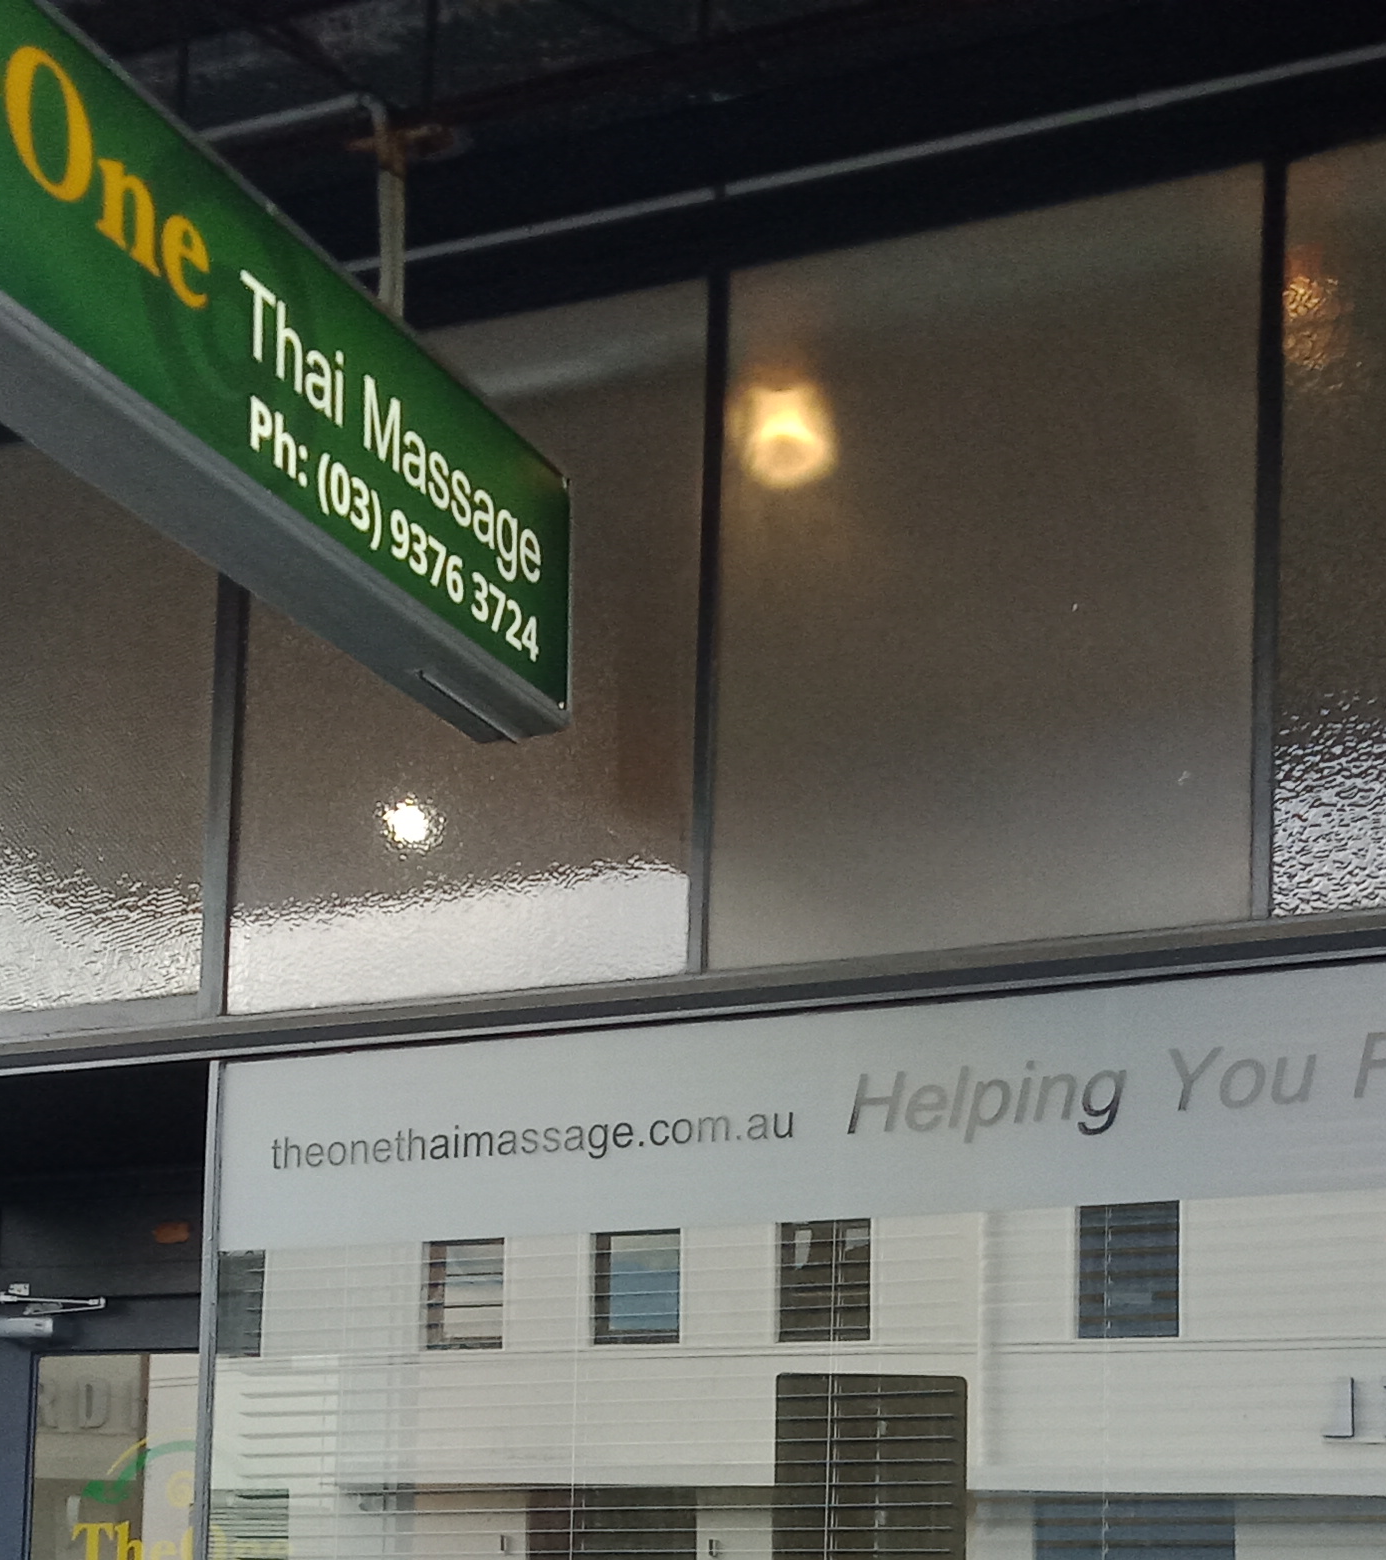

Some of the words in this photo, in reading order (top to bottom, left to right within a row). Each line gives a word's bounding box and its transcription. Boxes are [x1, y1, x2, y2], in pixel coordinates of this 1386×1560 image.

[240, 269, 345, 428] Thai
[363, 374, 541, 584] Massage
[250, 394, 308, 488] Ph:
[318, 452, 382, 551] (03)
[390, 509, 464, 604] 9376
[471, 571, 539, 662] 3724
[271, 1106, 795, 1171] theonethaimassage.com.au
[847, 1060, 1126, 1143] Helping
[1168, 1046, 1316, 1111] You
